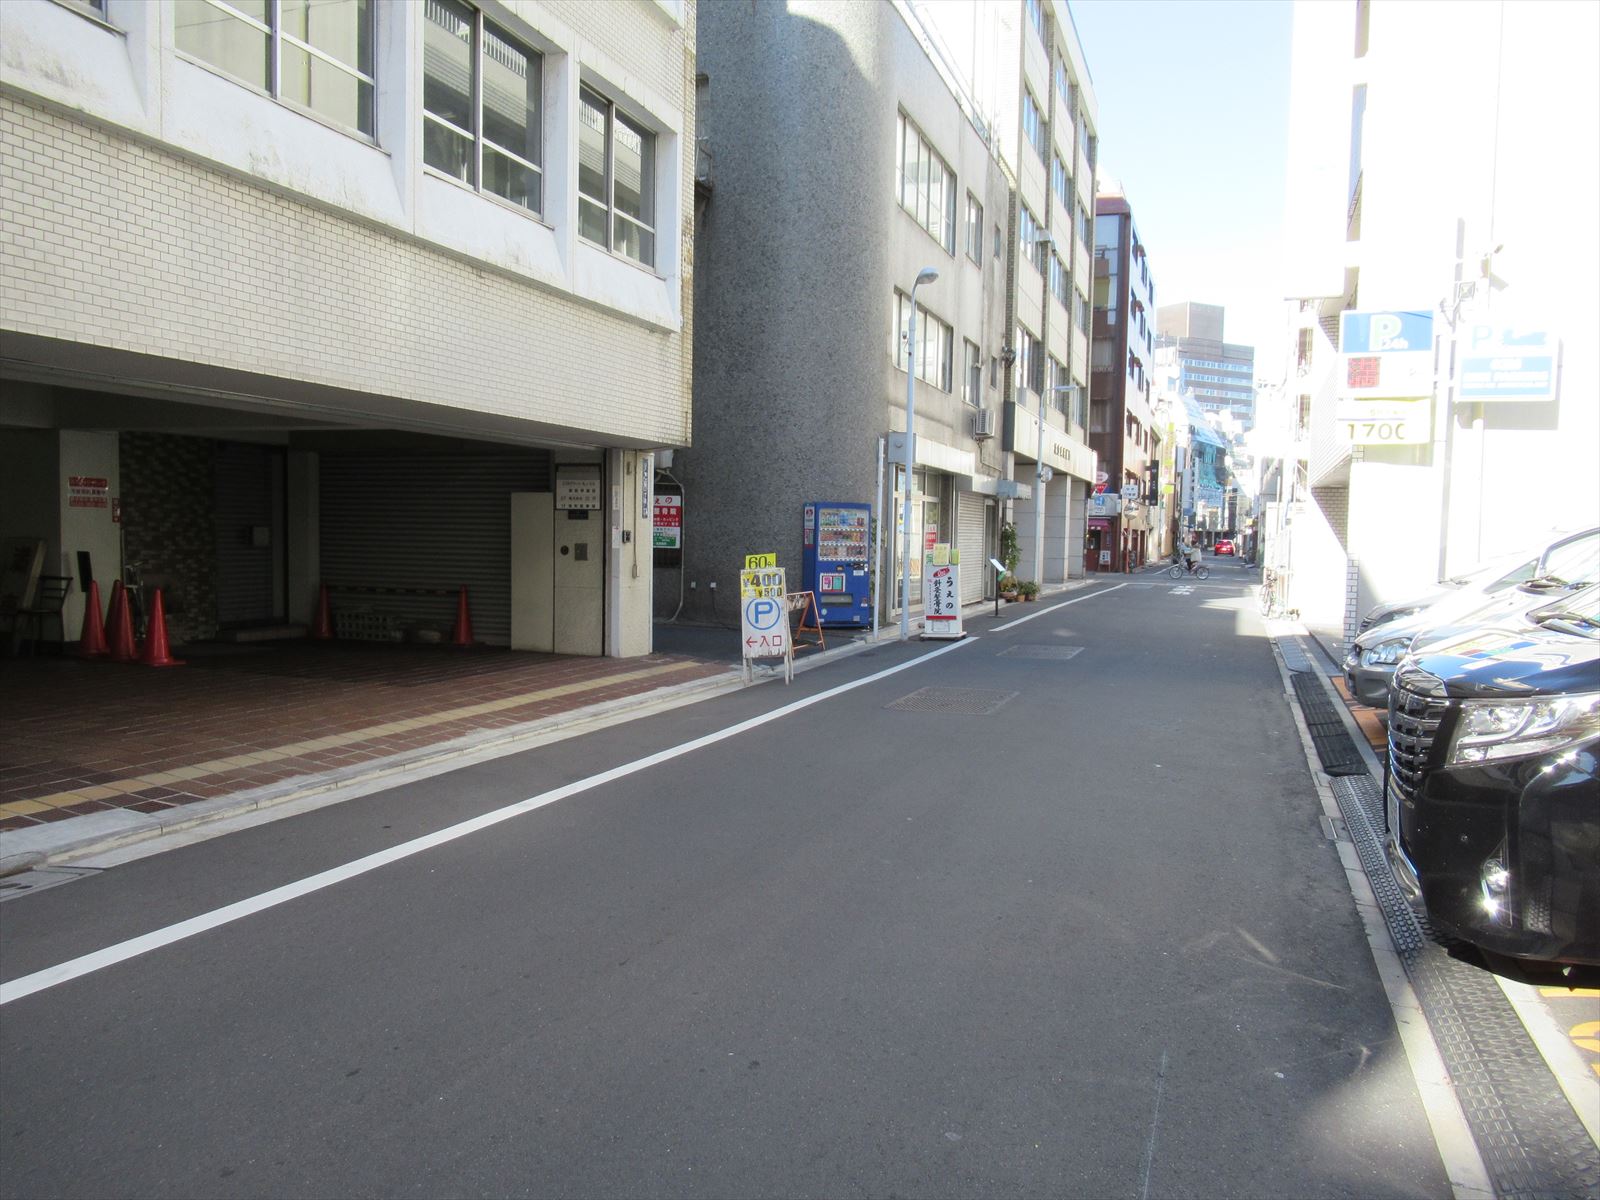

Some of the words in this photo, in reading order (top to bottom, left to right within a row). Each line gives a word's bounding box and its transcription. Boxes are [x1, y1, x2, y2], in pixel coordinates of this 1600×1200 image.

[945, 577, 954, 609] うえの
[754, 601, 774, 624] P
[759, 635, 782, 648] 入口
